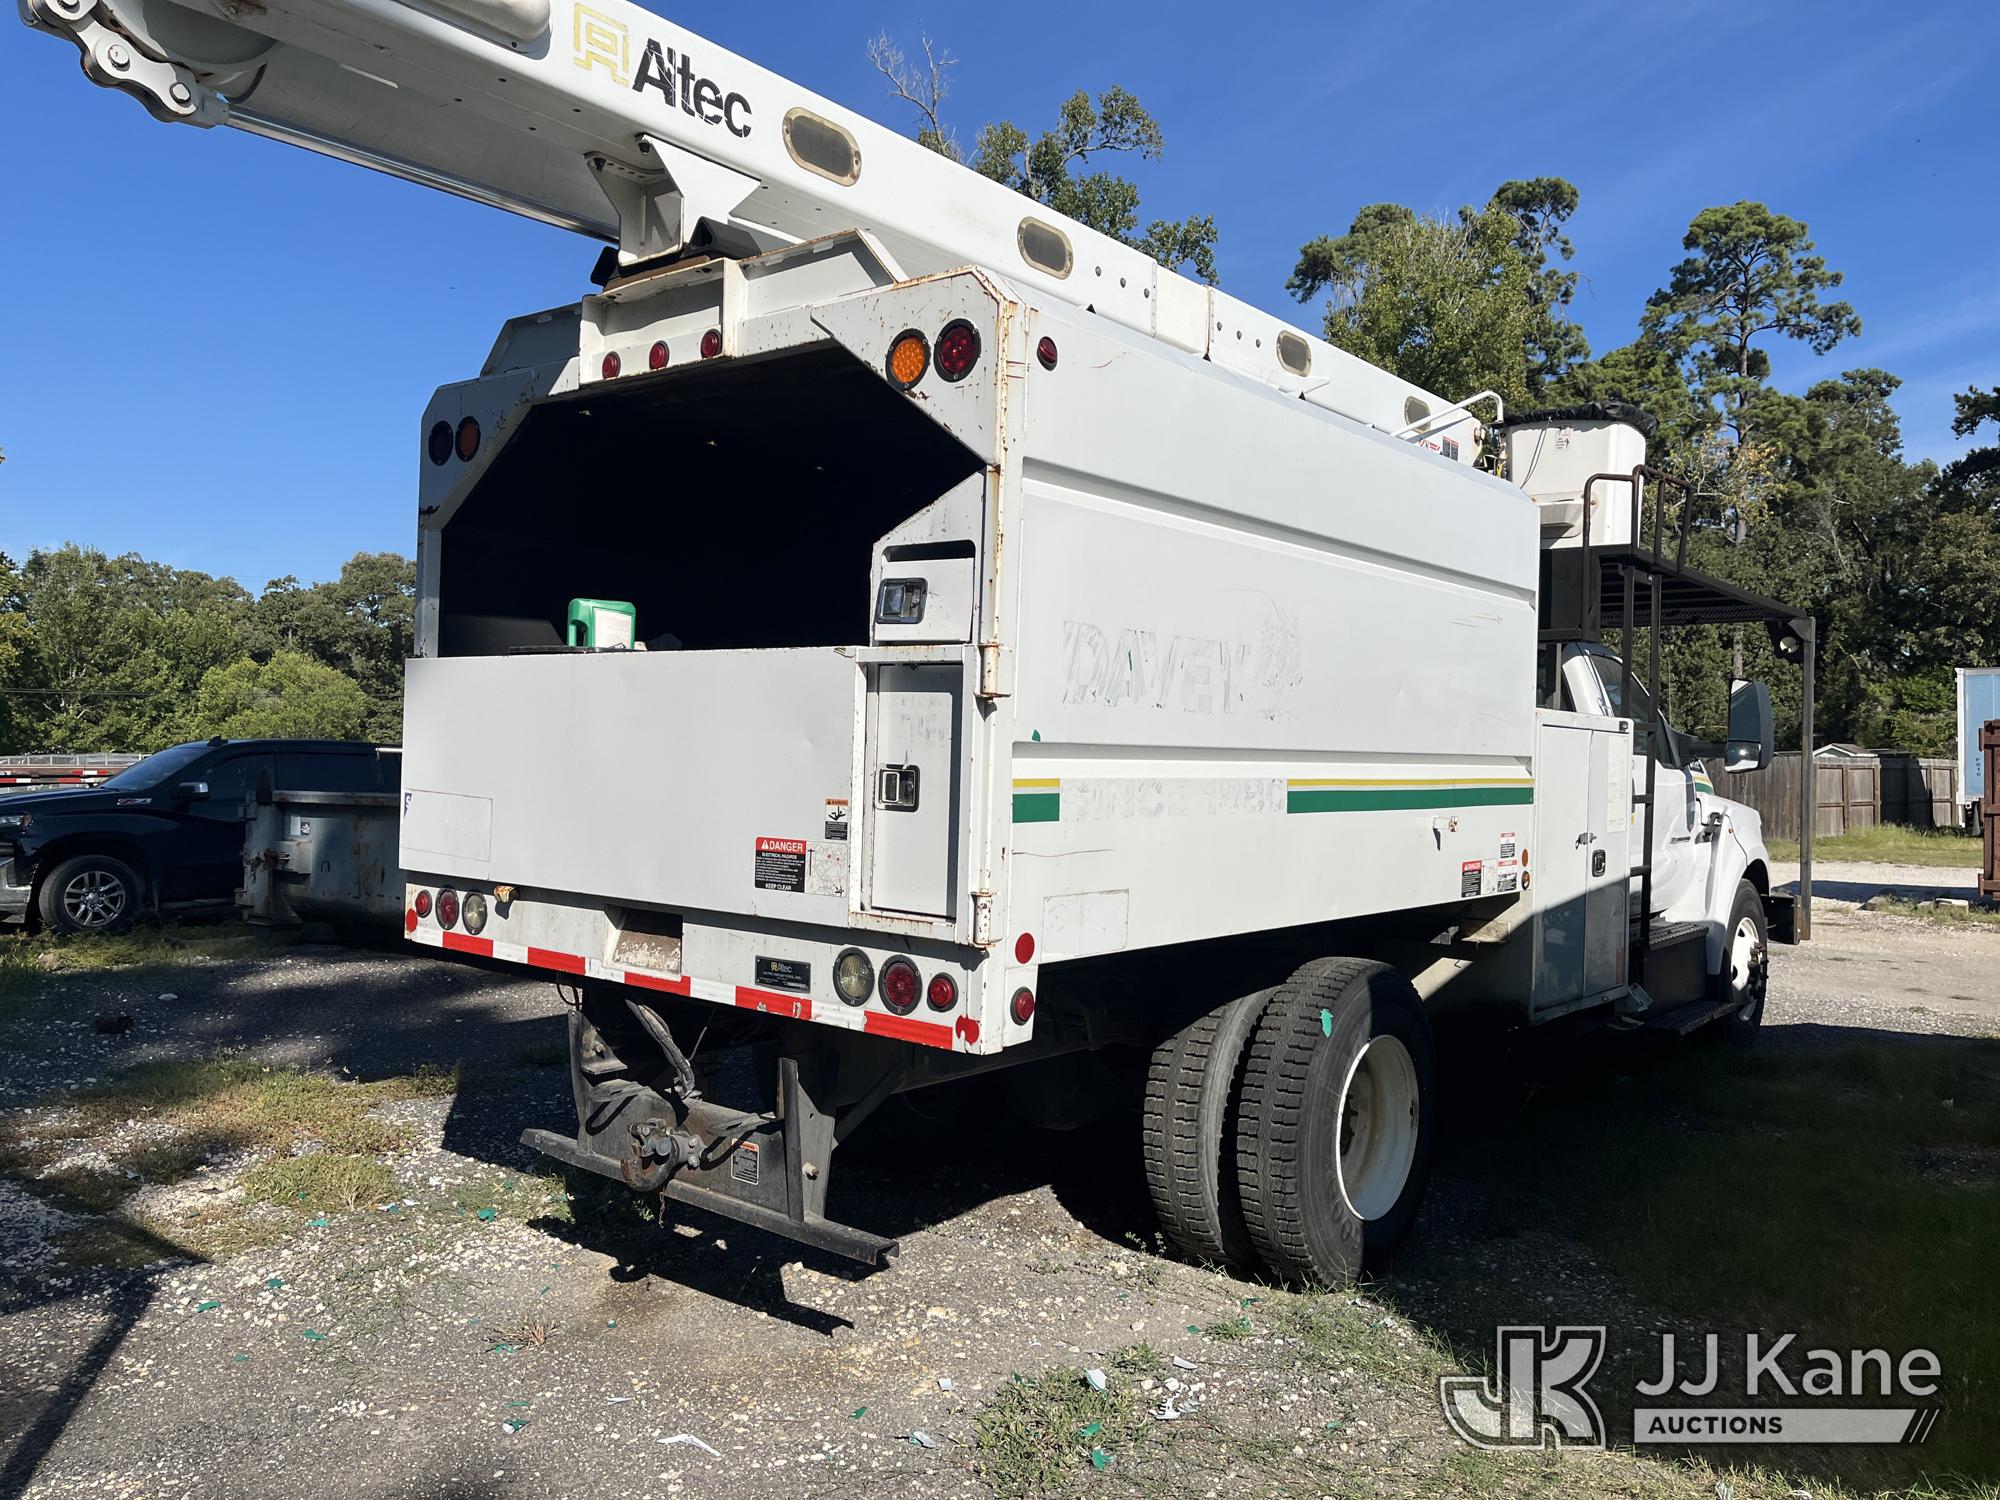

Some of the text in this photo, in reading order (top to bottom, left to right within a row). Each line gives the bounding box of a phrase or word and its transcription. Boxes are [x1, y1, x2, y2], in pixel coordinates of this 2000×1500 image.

[632, 38, 753, 138] Altec
[1063, 620, 1252, 715] DAVEY
[769, 840, 803, 852] DANGER
[778, 962, 792, 973] Altec
